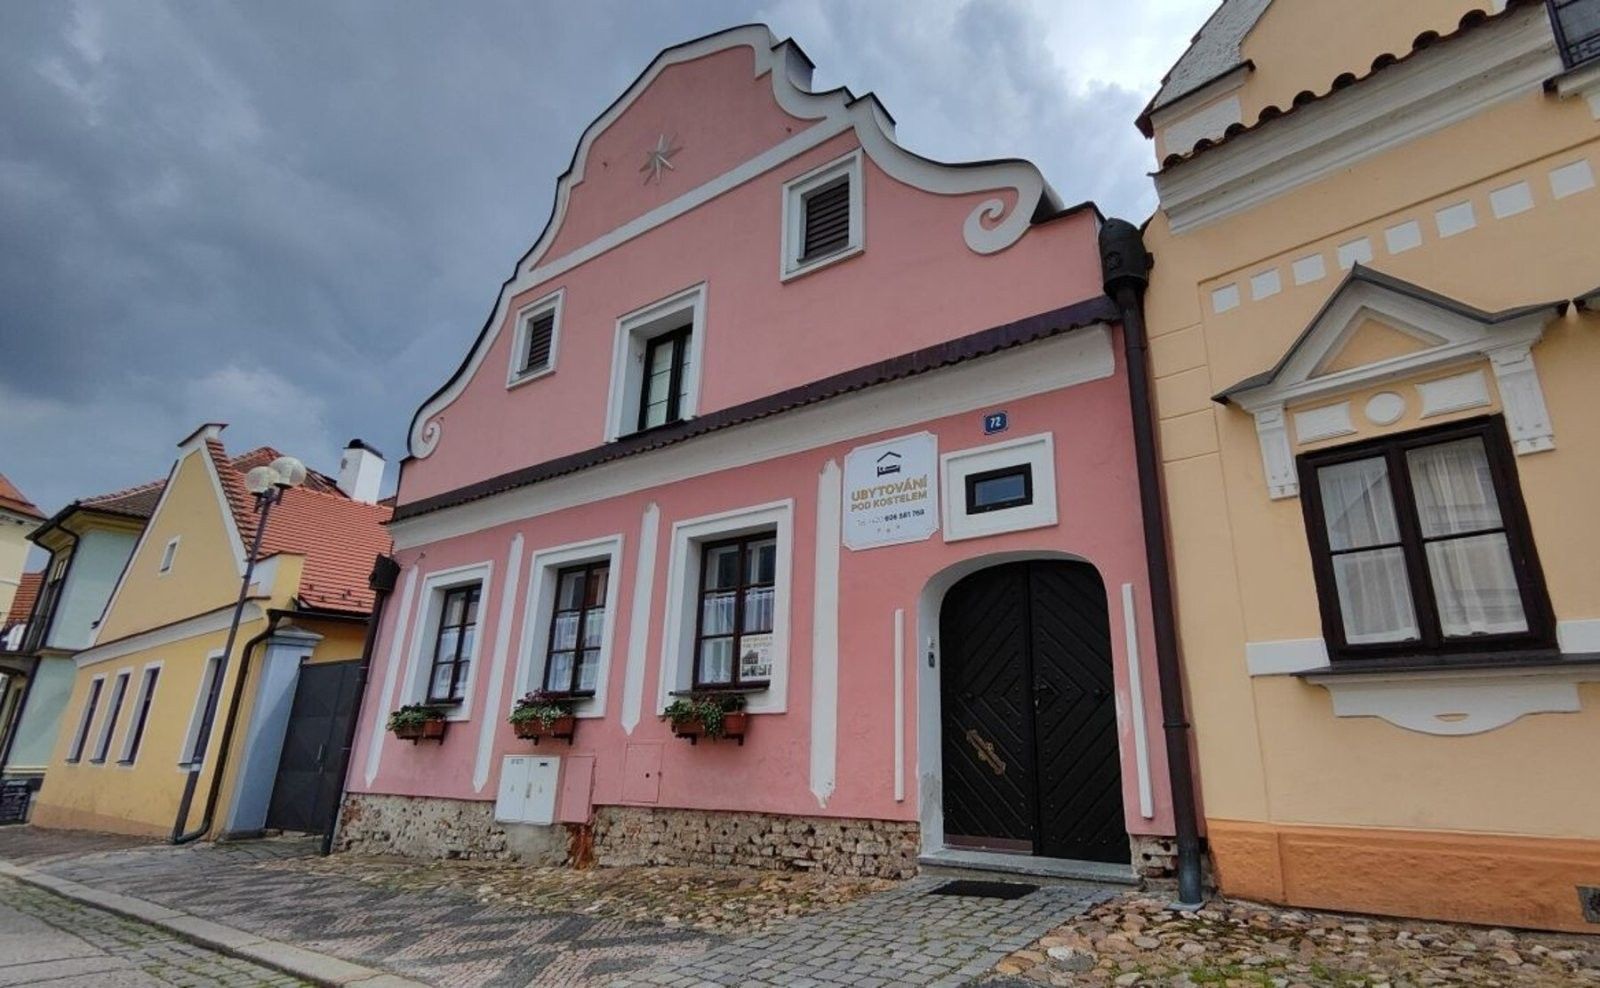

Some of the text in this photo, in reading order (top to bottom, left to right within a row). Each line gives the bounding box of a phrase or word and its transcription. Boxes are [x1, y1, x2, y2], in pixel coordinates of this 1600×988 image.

[990, 416, 1001, 428] 72
[851, 474, 928, 501] UBYTOVÁNÍ
[851, 491, 928, 512] POD KOSTELEM
